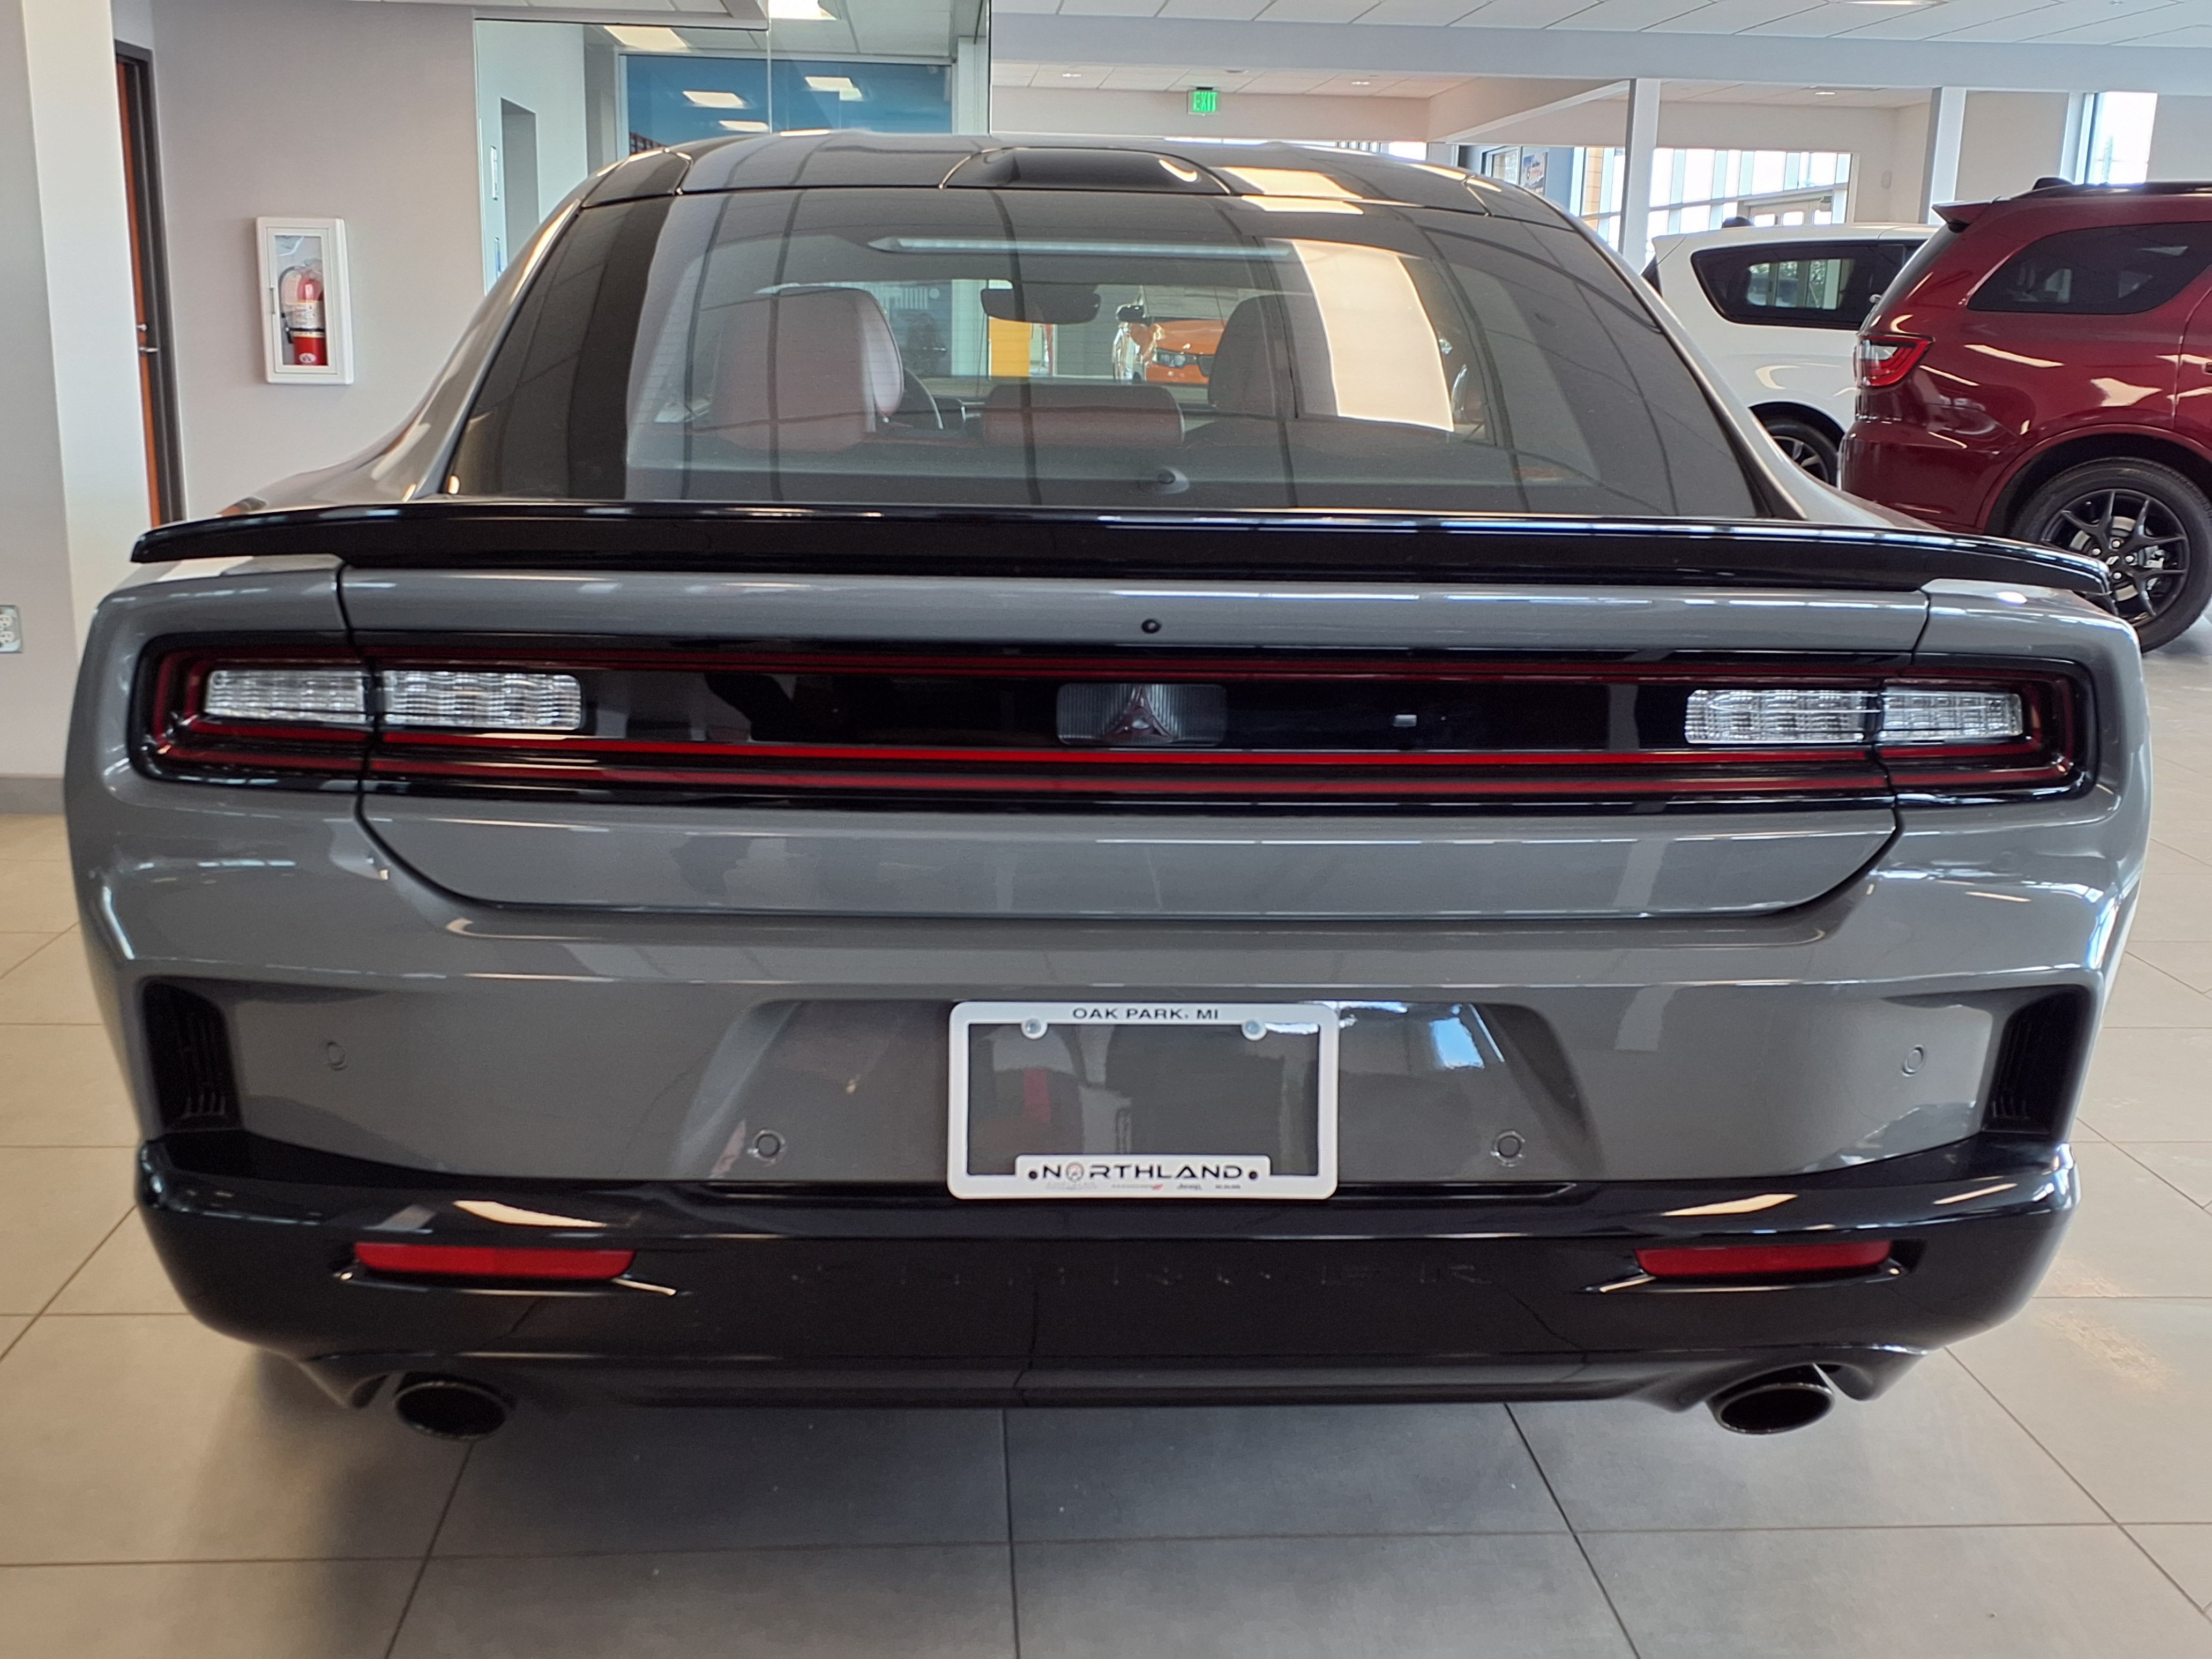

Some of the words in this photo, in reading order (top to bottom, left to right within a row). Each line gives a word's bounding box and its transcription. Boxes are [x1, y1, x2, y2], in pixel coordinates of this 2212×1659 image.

[1193, 91, 1217, 112] EXIT
[1073, 1007, 1118, 1019] OAK
[1197, 1009, 1218, 1020] MI
[1042, 1161, 1243, 1182] NORTHLAND
